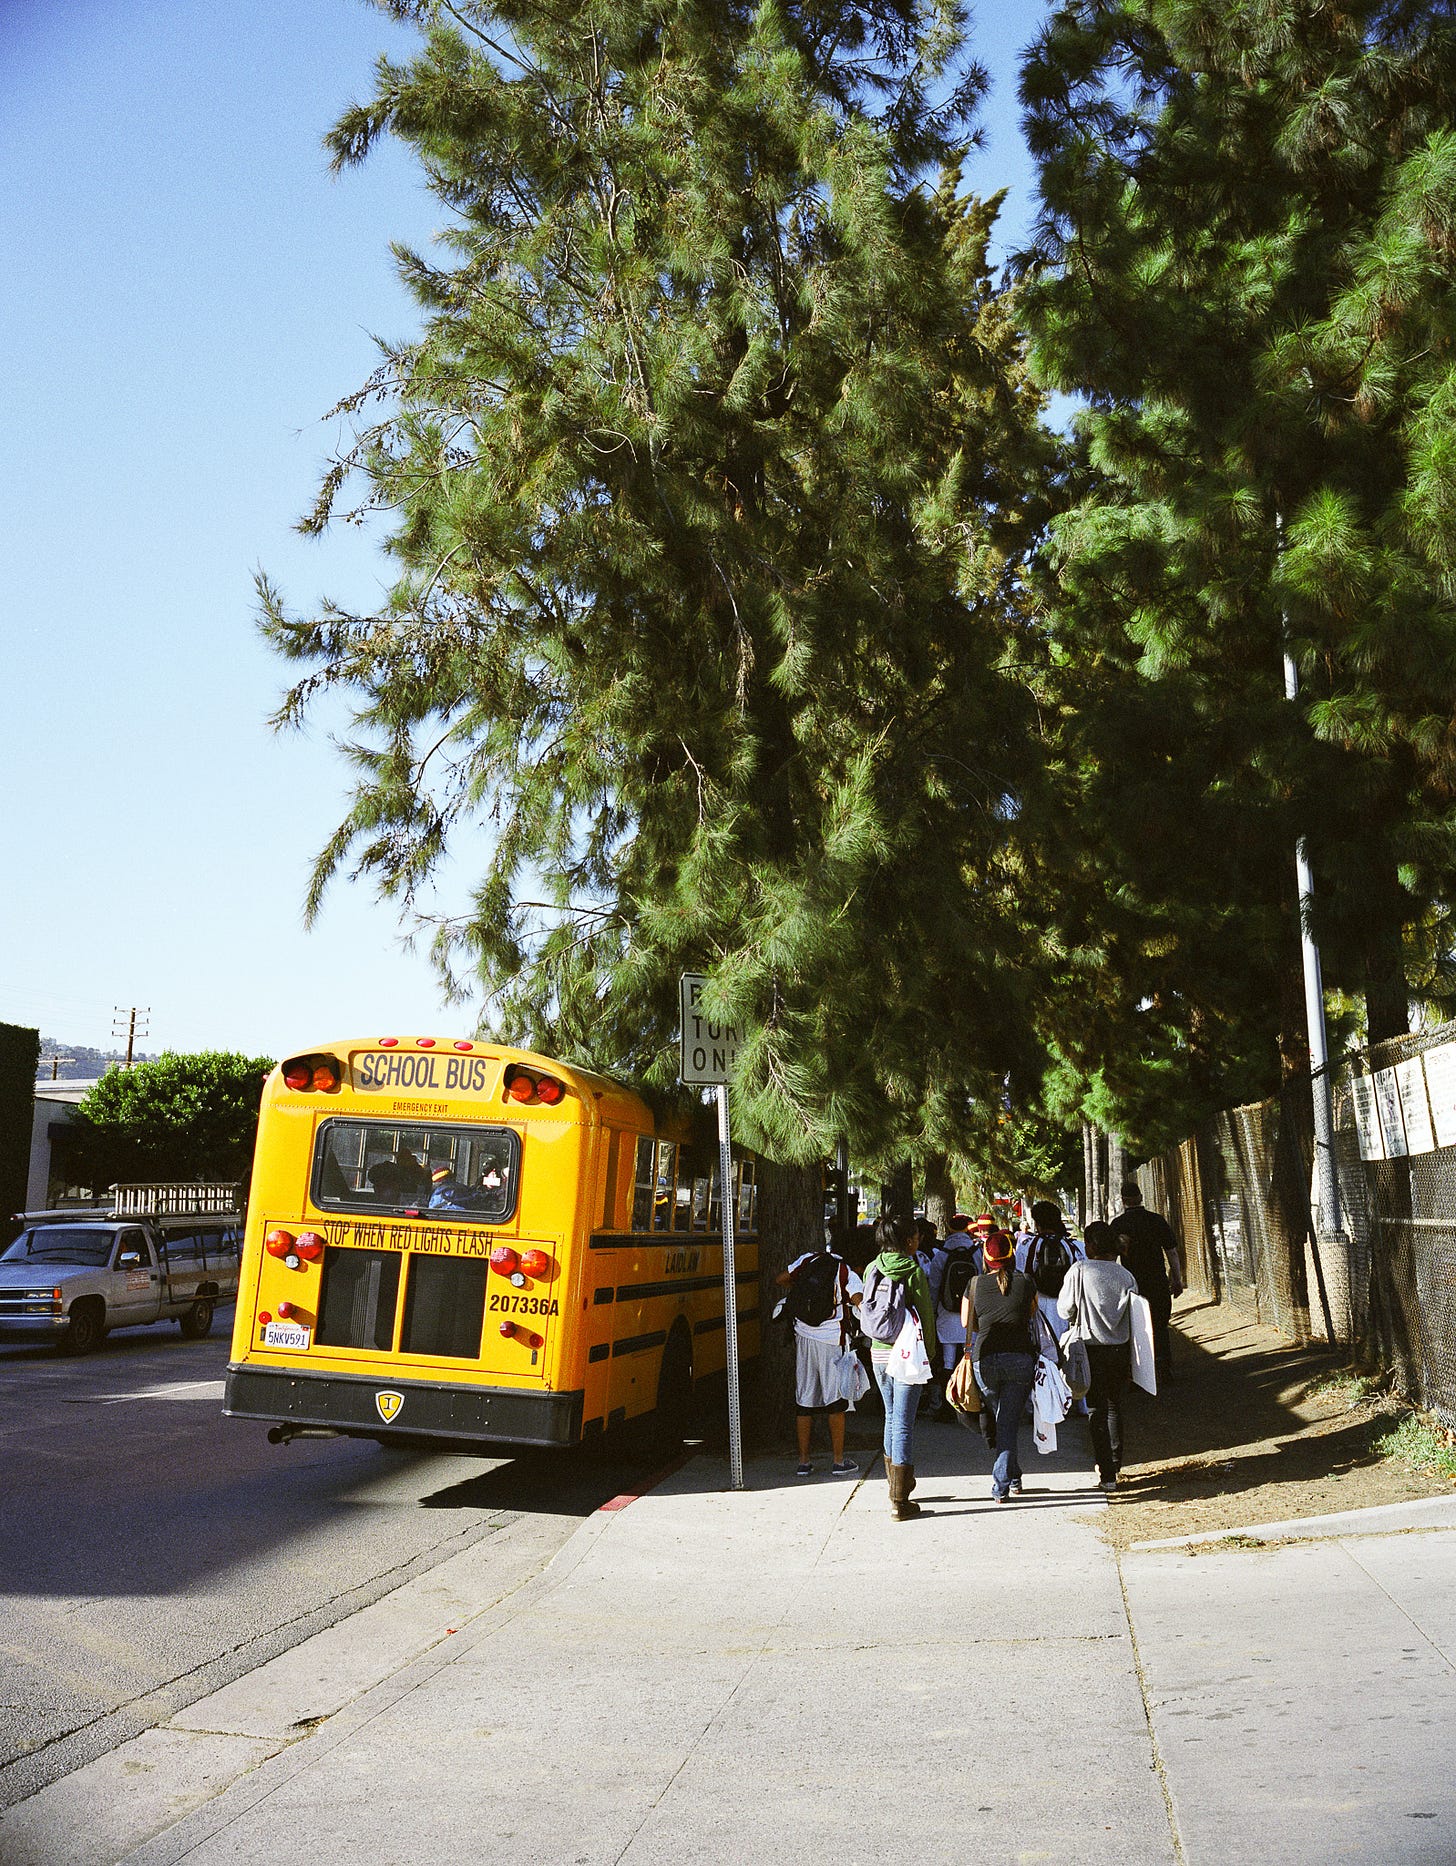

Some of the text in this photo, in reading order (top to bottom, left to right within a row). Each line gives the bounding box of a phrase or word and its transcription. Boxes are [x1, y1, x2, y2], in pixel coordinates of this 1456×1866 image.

[360, 1053, 487, 1091] SCHOOL BUS
[392, 1101, 449, 1113] EMERGENCY EXIT
[323, 1219, 495, 1256] STOP WHEN RED LIGHTS FLASH
[489, 1294, 559, 1316] 207336A
[268, 1331, 306, 1346] 5NKV591
